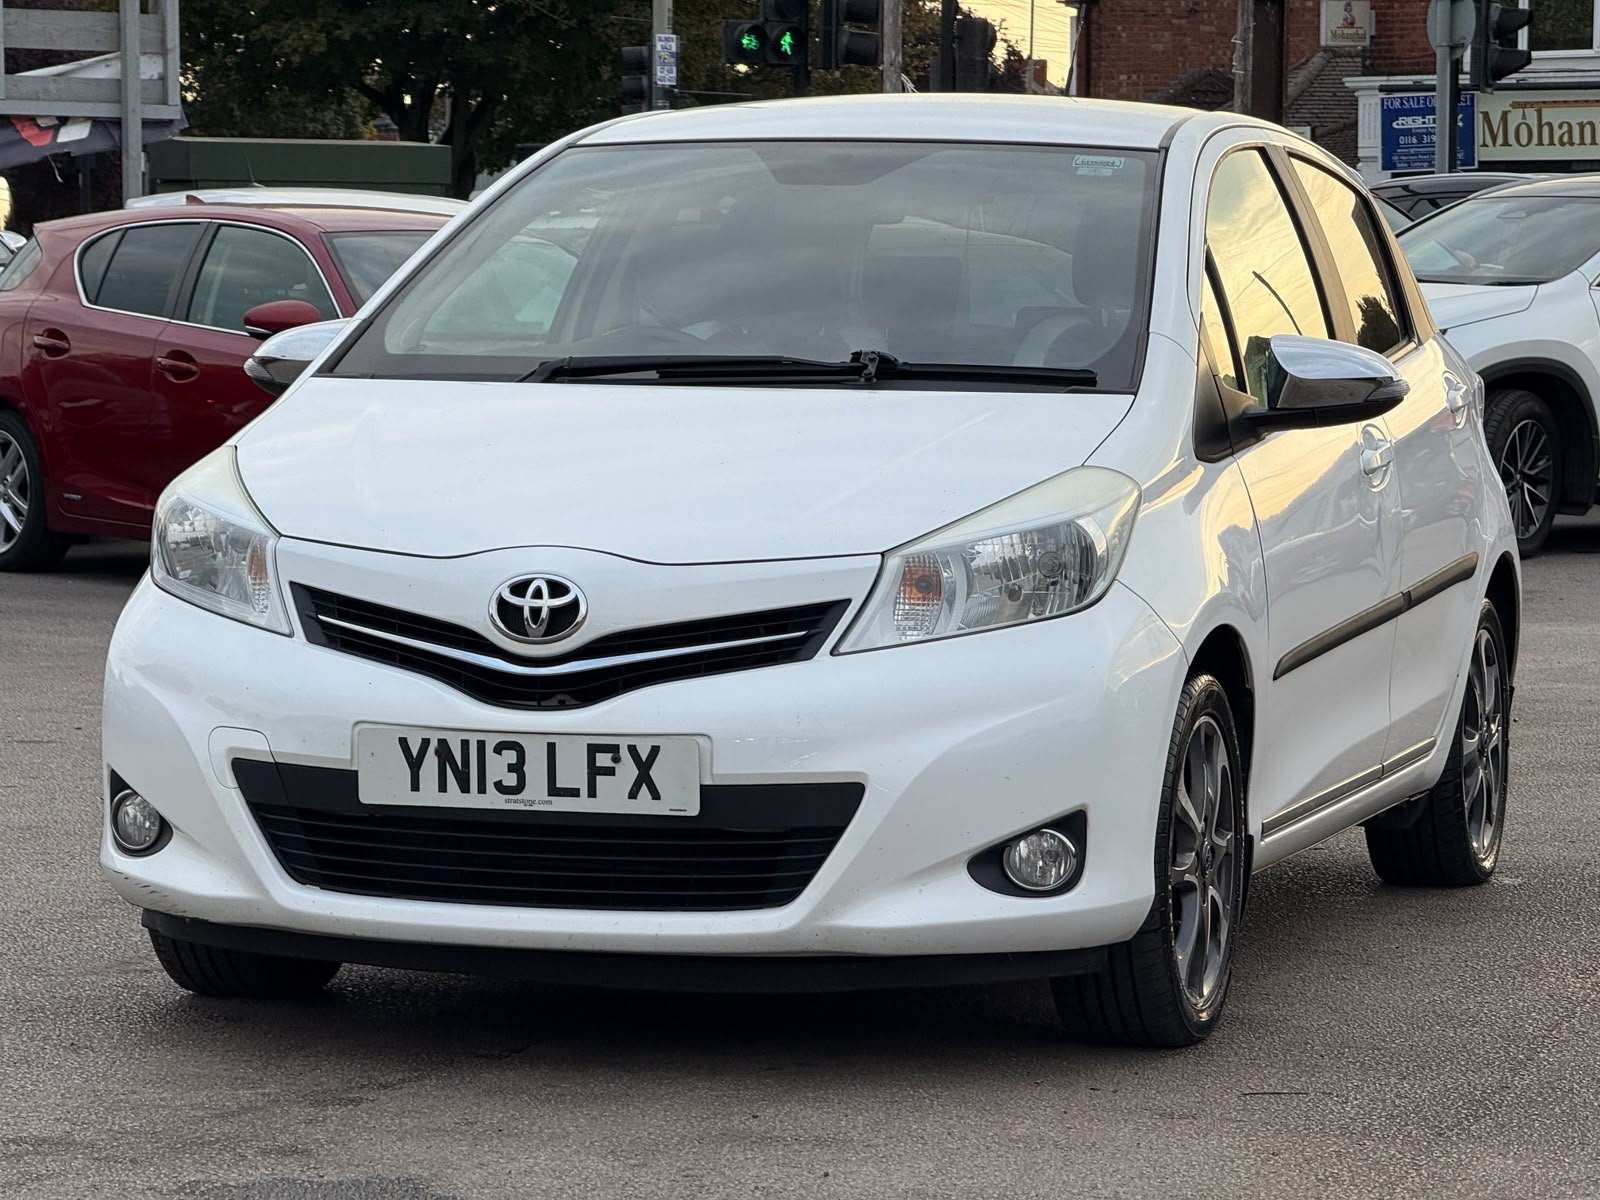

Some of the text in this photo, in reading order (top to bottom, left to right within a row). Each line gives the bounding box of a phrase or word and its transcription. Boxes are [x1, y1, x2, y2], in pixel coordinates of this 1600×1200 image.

[1383, 97, 1401, 109] FOR
[1402, 96, 1426, 108] SALE
[1479, 107, 1600, 147] Mohan
[1398, 136, 1418, 144] 0116
[398, 736, 662, 801] YN13 LFX
[504, 797, 553, 806] stratstone.com
